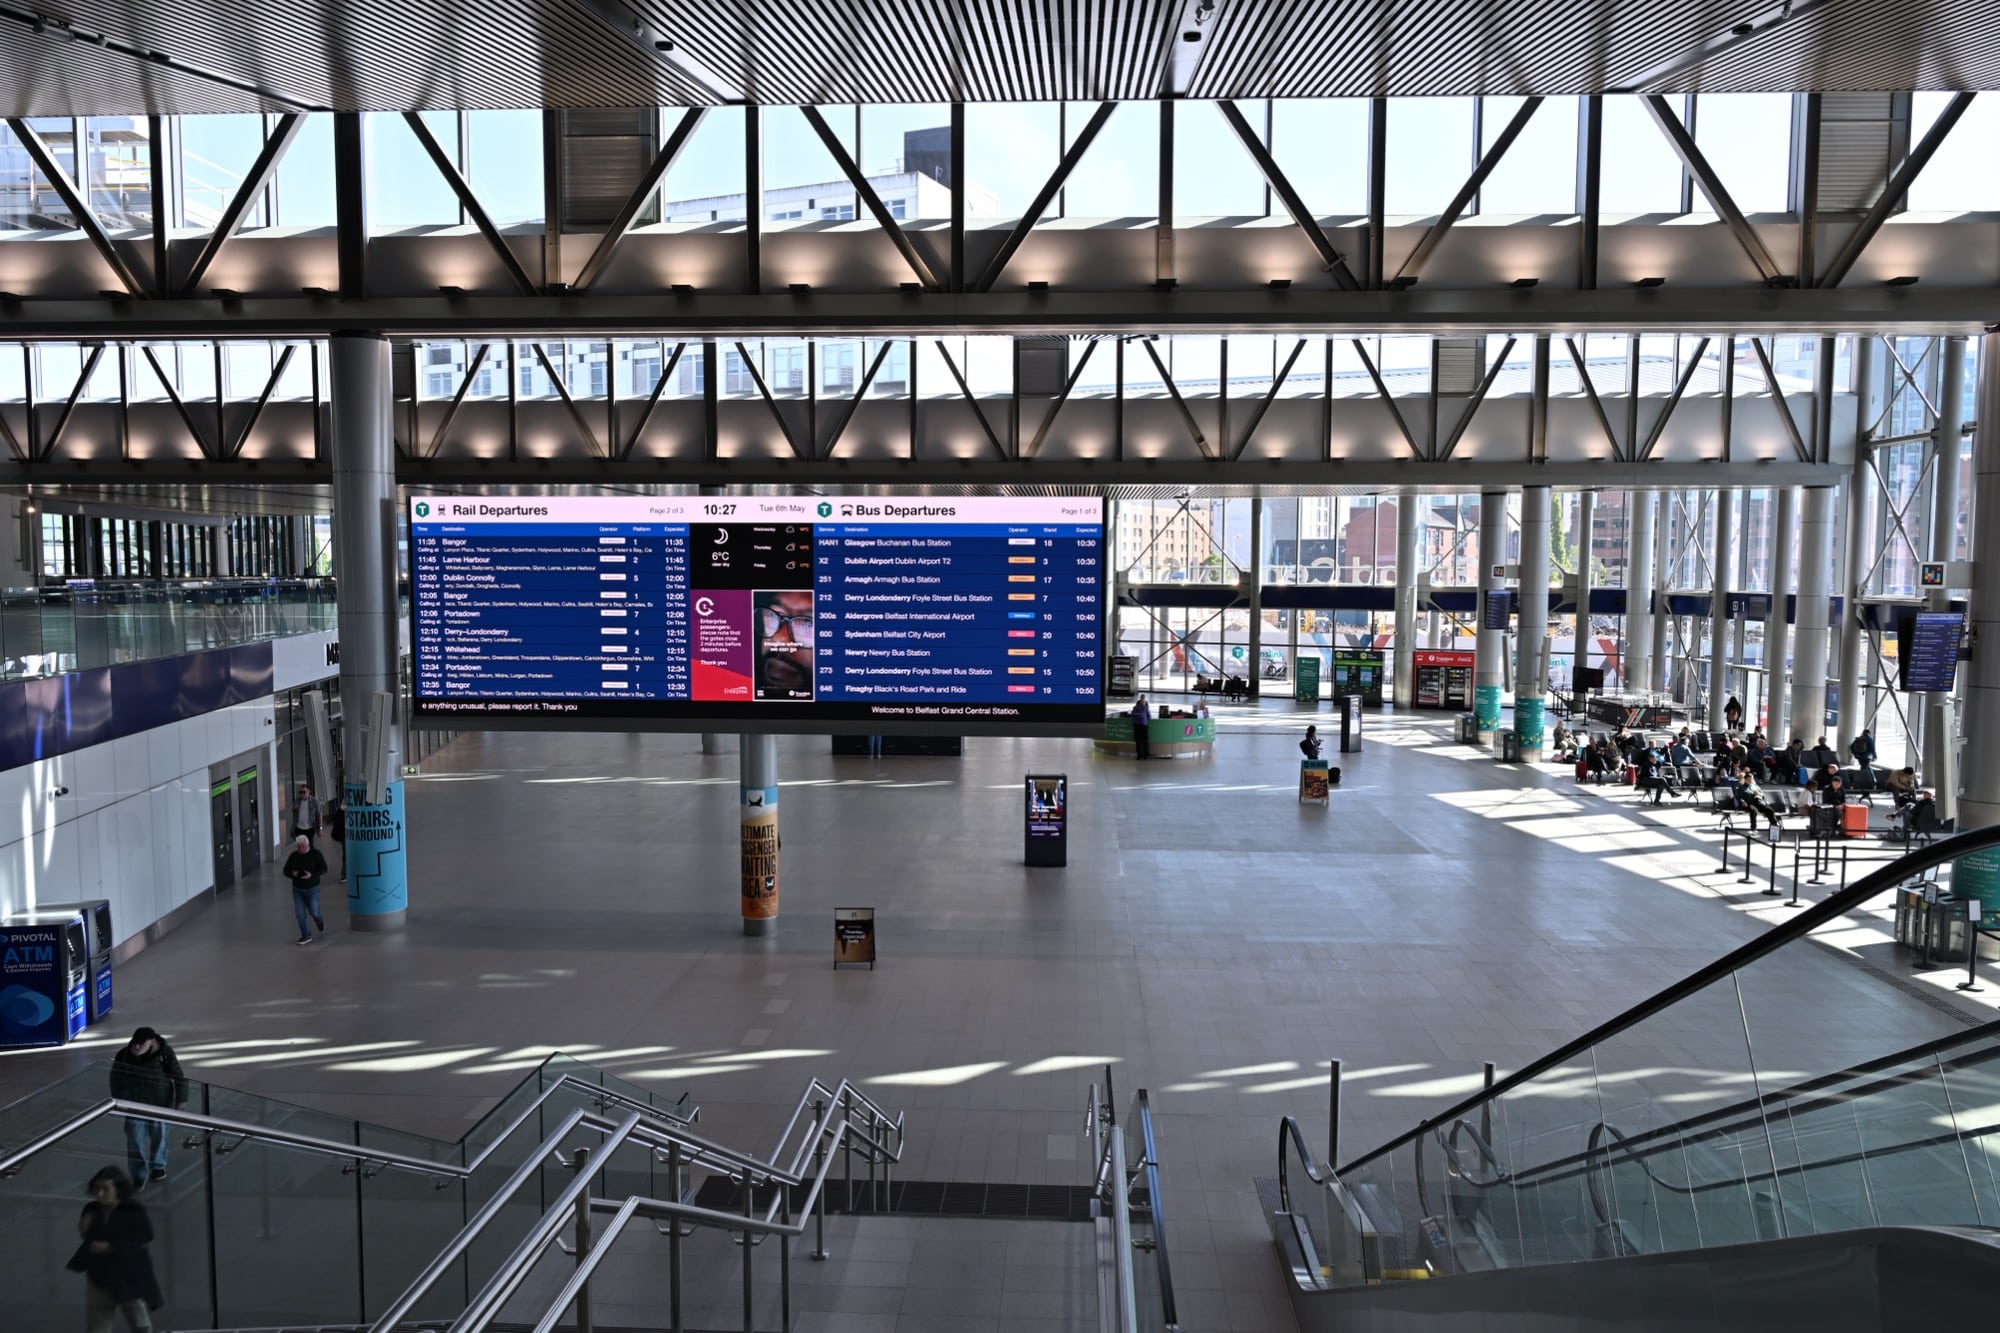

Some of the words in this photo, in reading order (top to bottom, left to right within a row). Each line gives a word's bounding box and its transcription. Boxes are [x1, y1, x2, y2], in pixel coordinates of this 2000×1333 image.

[453, 505, 476, 515] Rail
[480, 505, 548, 517] Departures
[704, 504, 736, 515] 10:27
[760, 504, 774, 512] Tue
[789, 505, 805, 513] May
[856, 505, 880, 515] Bus
[885, 505, 956, 518] Departures
[442, 538, 466, 546] Bangor
[845, 539, 875, 547] Glasgow
[466, 574, 495, 582] Connolly
[845, 576, 873, 584] Armagh
[873, 576, 900, 584] Armagh
[444, 592, 468, 601] Bangor
[845, 594, 864, 602] Derry
[912, 594, 931, 602] Foyle
[845, 631, 882, 639] Sydenham
[908, 631, 921, 639] City
[845, 649, 868, 657] Newry
[869, 649, 890, 657] Newry
[845, 667, 865, 675] Derry
[912, 667, 931, 676] Foyle
[845, 685, 873, 693] Finaghy
[428, 702, 457, 711] anything
[992, 707, 1019, 715] Station.
[11, 933, 57, 943] PIVOTAL
[4, 945, 53, 963] ATM
[98, 977, 111, 994] ATM
[70, 995, 84, 1012] ATM
